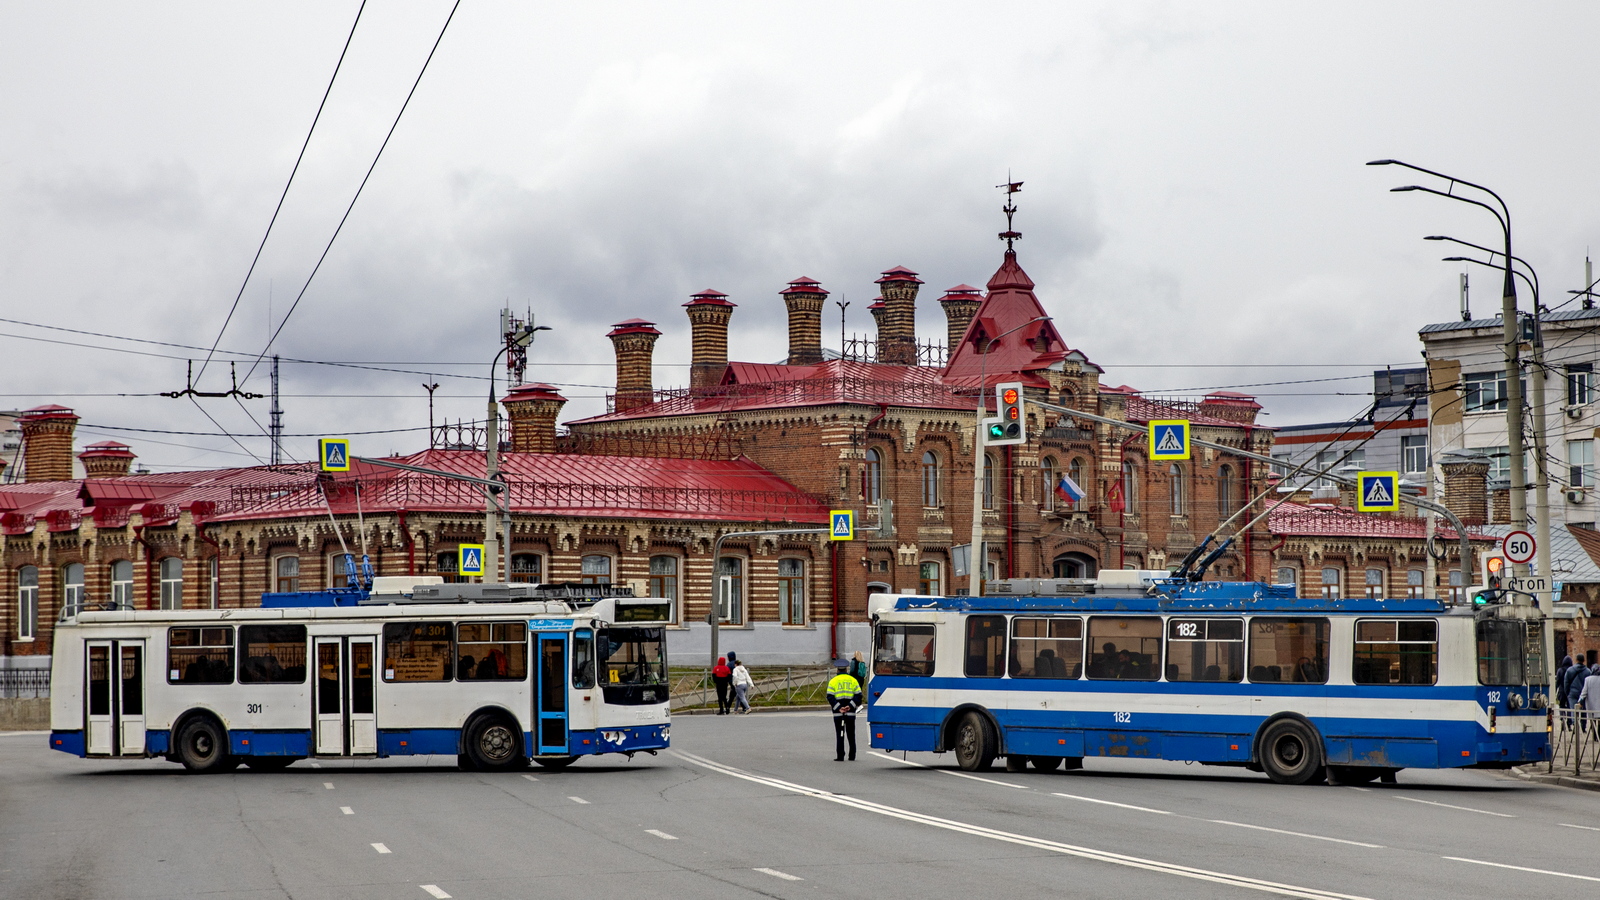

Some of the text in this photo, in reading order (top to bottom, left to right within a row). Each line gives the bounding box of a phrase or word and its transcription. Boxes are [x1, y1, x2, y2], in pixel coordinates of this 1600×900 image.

[1511, 541, 1528, 554] 50
[1508, 578, 1545, 591] СТОП
[428, 625, 446, 636] 301
[1176, 623, 1197, 637] 182
[1487, 691, 1501, 703] 182
[247, 703, 262, 714] 301
[1113, 711, 1131, 723] 182
